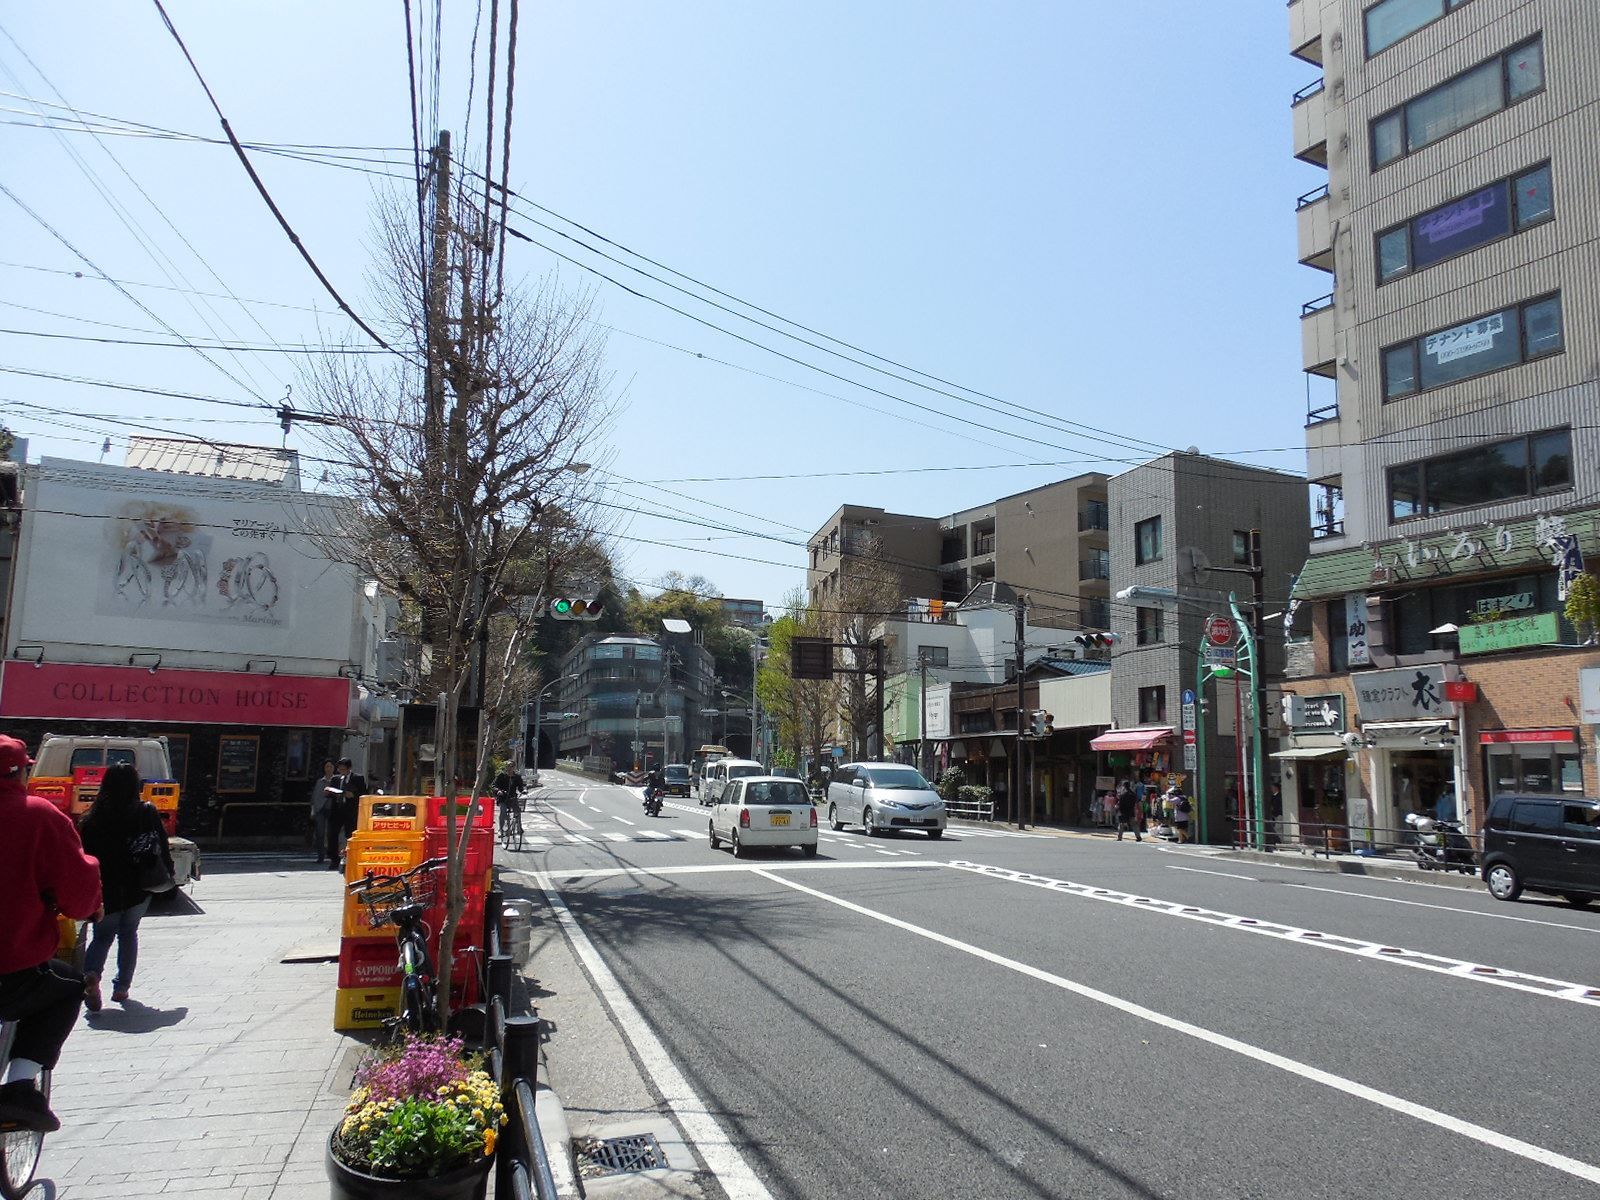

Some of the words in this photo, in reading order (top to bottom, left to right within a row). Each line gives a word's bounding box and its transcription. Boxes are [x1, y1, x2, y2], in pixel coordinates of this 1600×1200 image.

[232, 519, 280, 531] マリアージュ
[231, 529, 277, 541] この先すぐ
[1478, 594, 1532, 613] はまぐり
[53, 682, 220, 705] COLLECTION
[236, 690, 310, 709] HOUSE
[373, 821, 411, 830] アサヒビール
[355, 965, 397, 976] SAPPORO
[354, 1011, 393, 1020] Heineken
